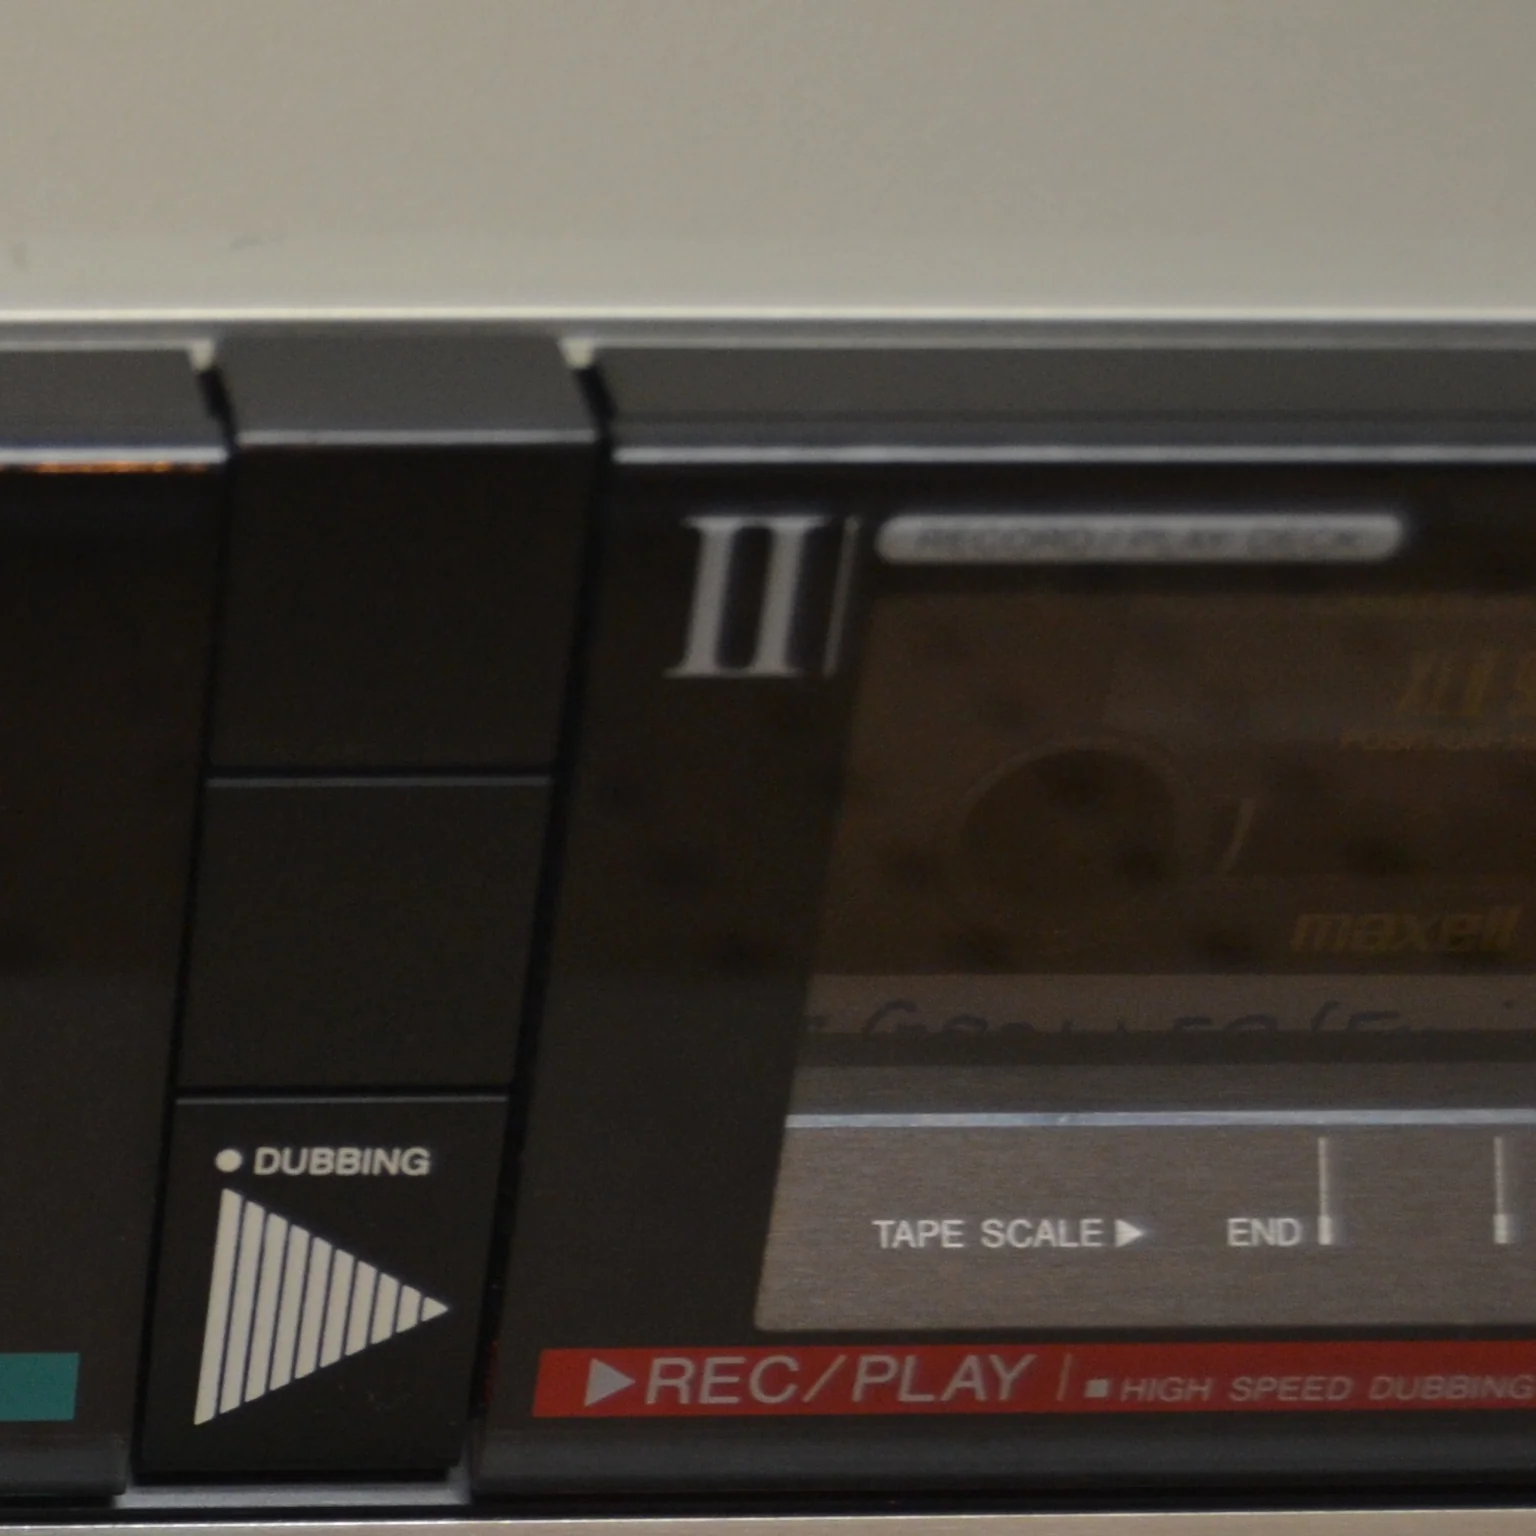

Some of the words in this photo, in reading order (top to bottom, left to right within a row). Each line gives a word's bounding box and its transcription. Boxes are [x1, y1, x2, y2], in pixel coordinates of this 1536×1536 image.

[1290, 907, 1522, 954] maxell
[254, 1146, 431, 1176] DUBBING
[872, 1218, 965, 1249] TAPE
[981, 1218, 1103, 1249] SCALE
[1227, 1216, 1303, 1247] END
[645, 1354, 1035, 1406] REC/PLAY
[1120, 1376, 1214, 1403] HIGH
[1228, 1375, 1354, 1403] SPEED
[1368, 1374, 1536, 1401] DUBBING
